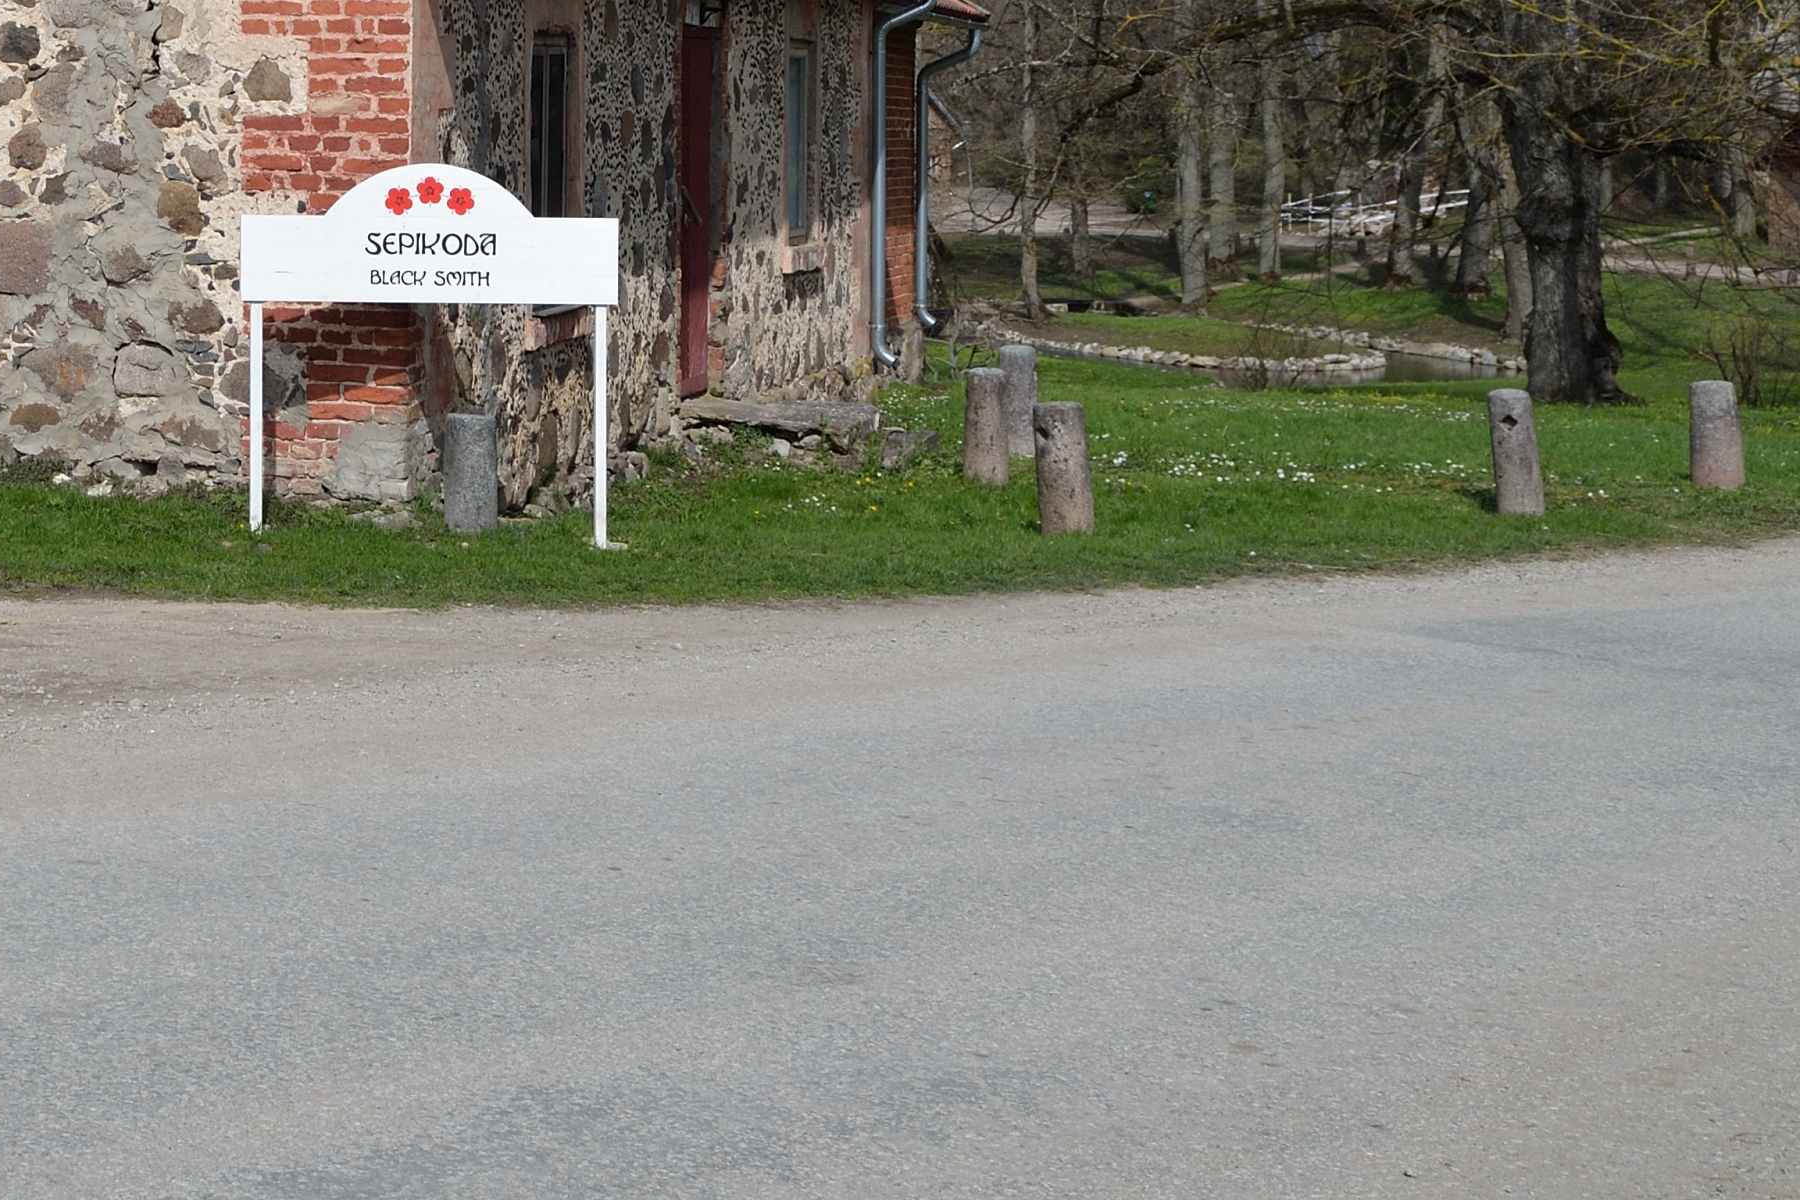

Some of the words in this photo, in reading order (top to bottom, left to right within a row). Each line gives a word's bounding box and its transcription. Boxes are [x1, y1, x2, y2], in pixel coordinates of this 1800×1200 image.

[364, 232, 497, 256] SEPIKODA
[370, 269, 427, 286] BLACK
[434, 270, 490, 287] SMITH
